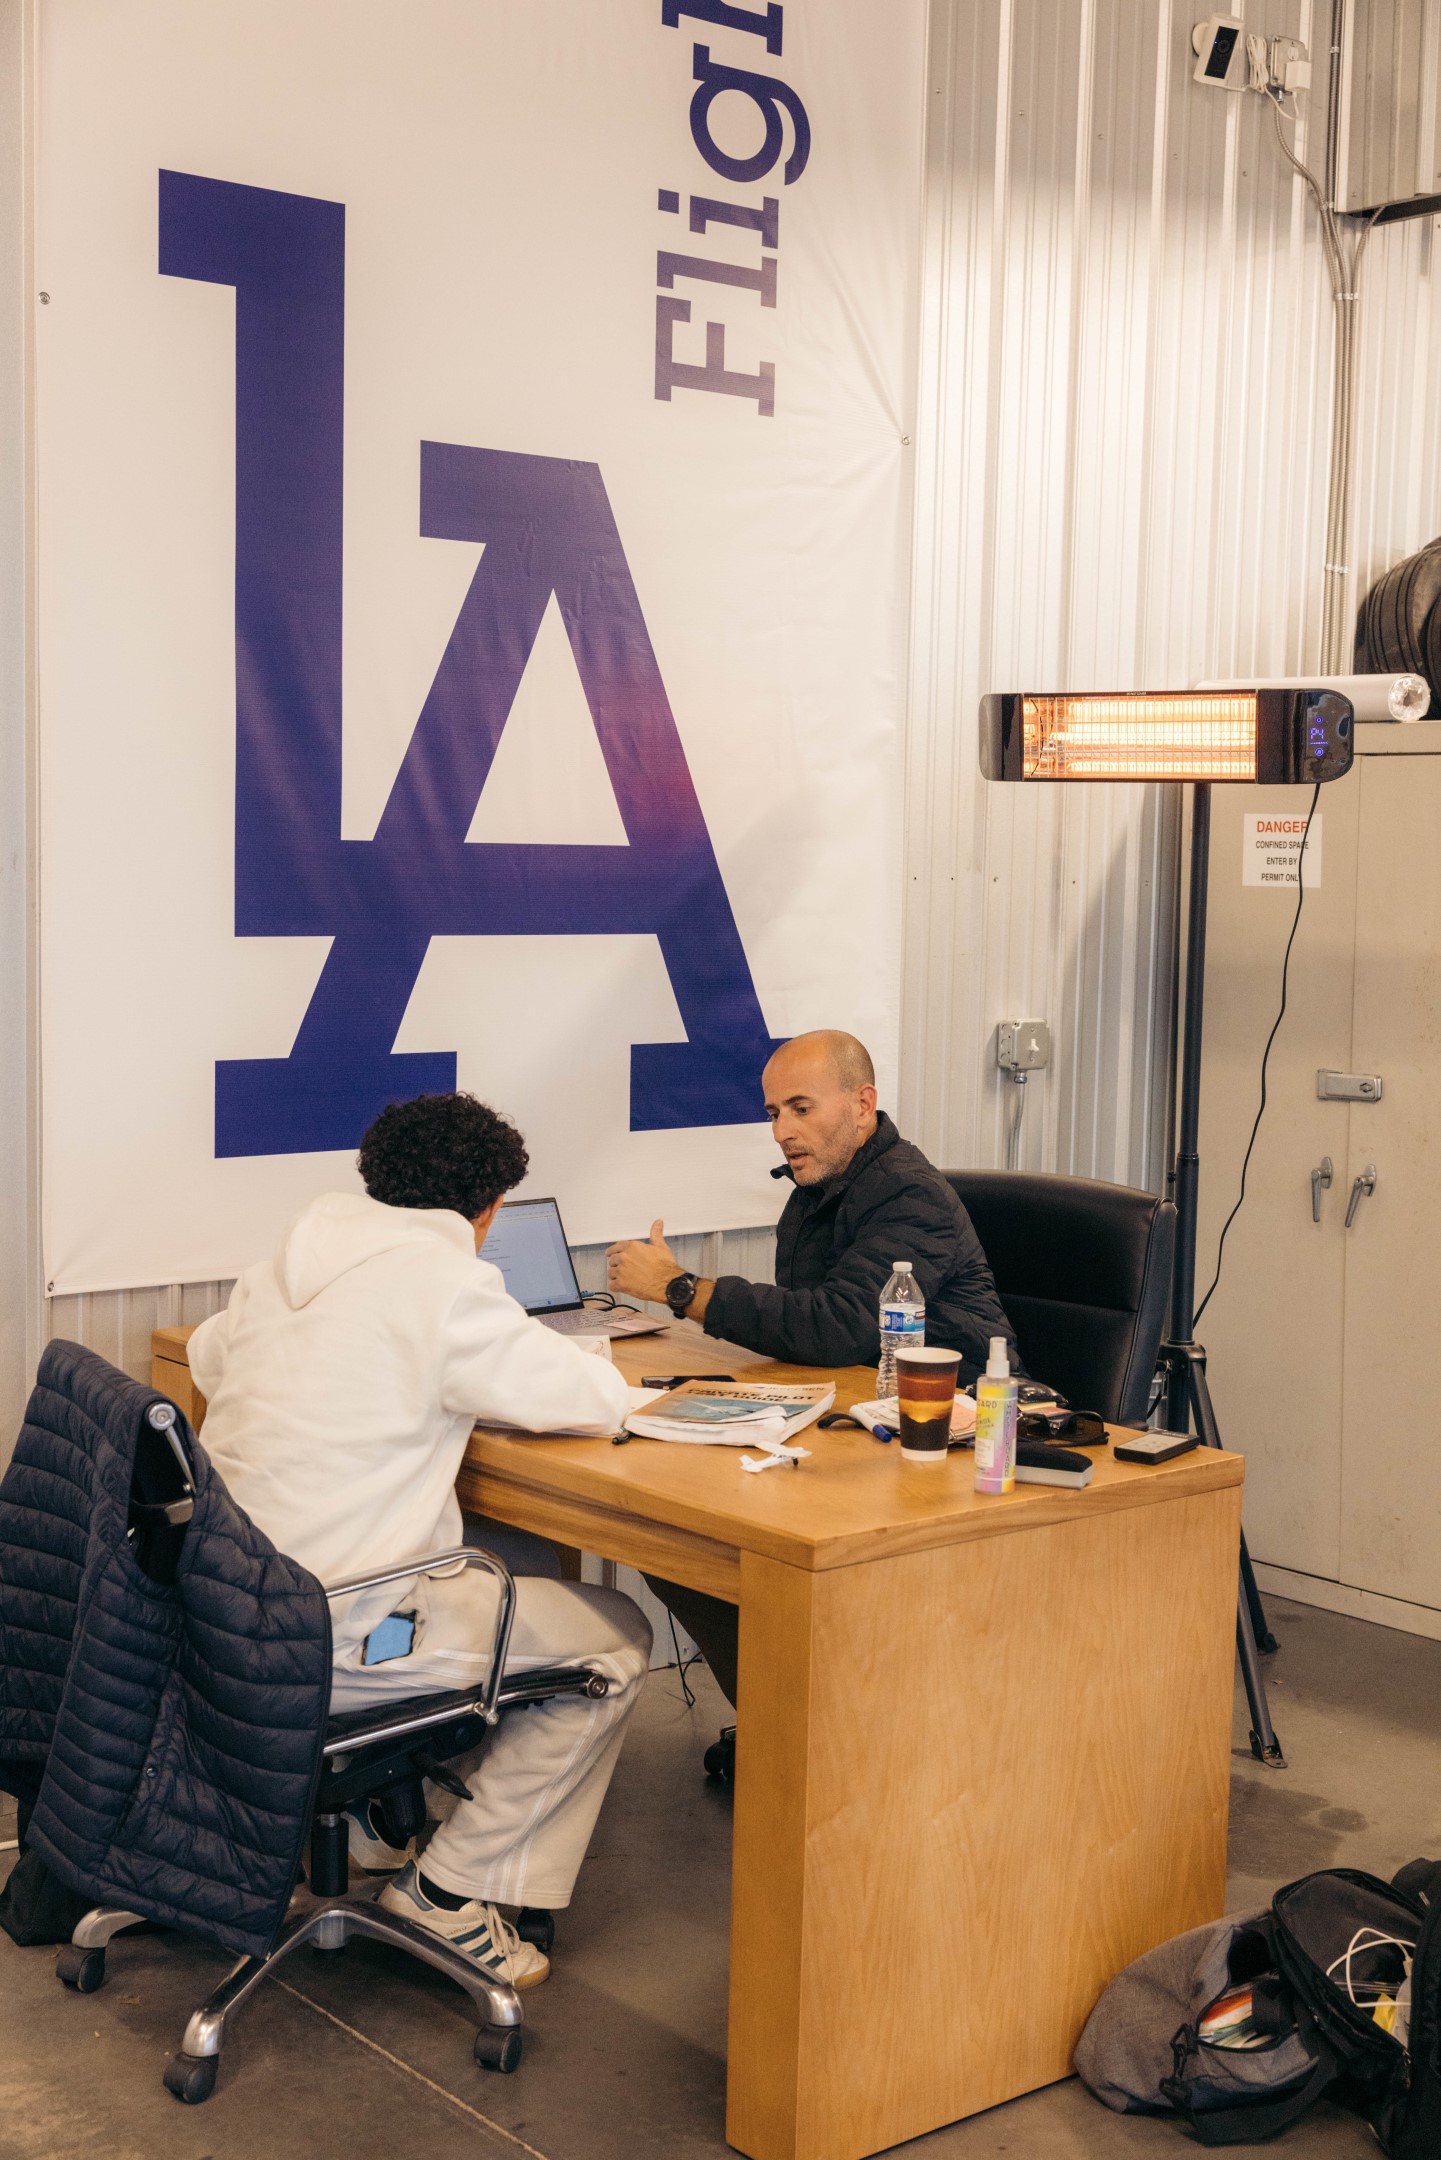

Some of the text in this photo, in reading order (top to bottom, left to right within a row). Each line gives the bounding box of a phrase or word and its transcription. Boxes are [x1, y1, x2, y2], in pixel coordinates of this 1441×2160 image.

[1255, 840, 1288, 849] CONFINED
[1266, 857, 1298, 866] ENTER BY
[1261, 873, 1299, 882] PERMIT ONL
